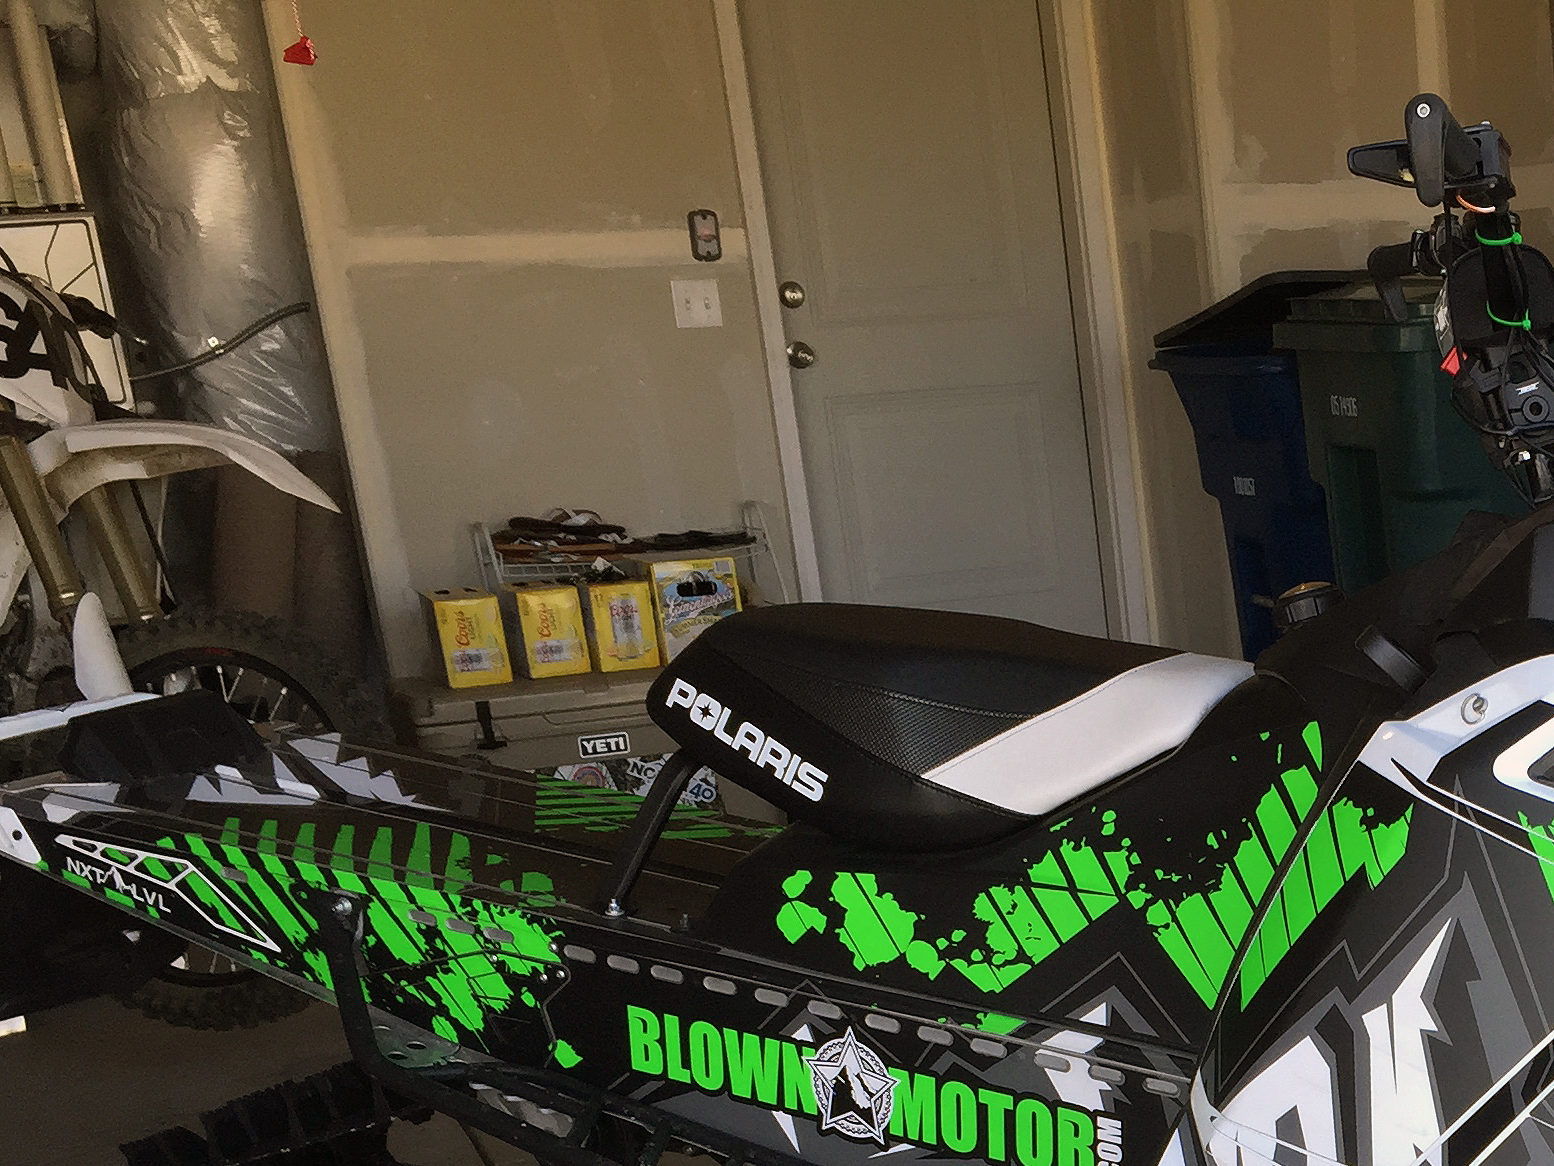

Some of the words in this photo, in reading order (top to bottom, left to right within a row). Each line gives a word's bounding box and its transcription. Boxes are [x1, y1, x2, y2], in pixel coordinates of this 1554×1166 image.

[581, 736, 626, 754] YETI
[665, 677, 829, 802] POLARIS
[689, 782, 715, 801] 40
[65, 856, 105, 884] NXT
[130, 883, 172, 914] LVL
[627, 1004, 819, 1117] BLOWN
